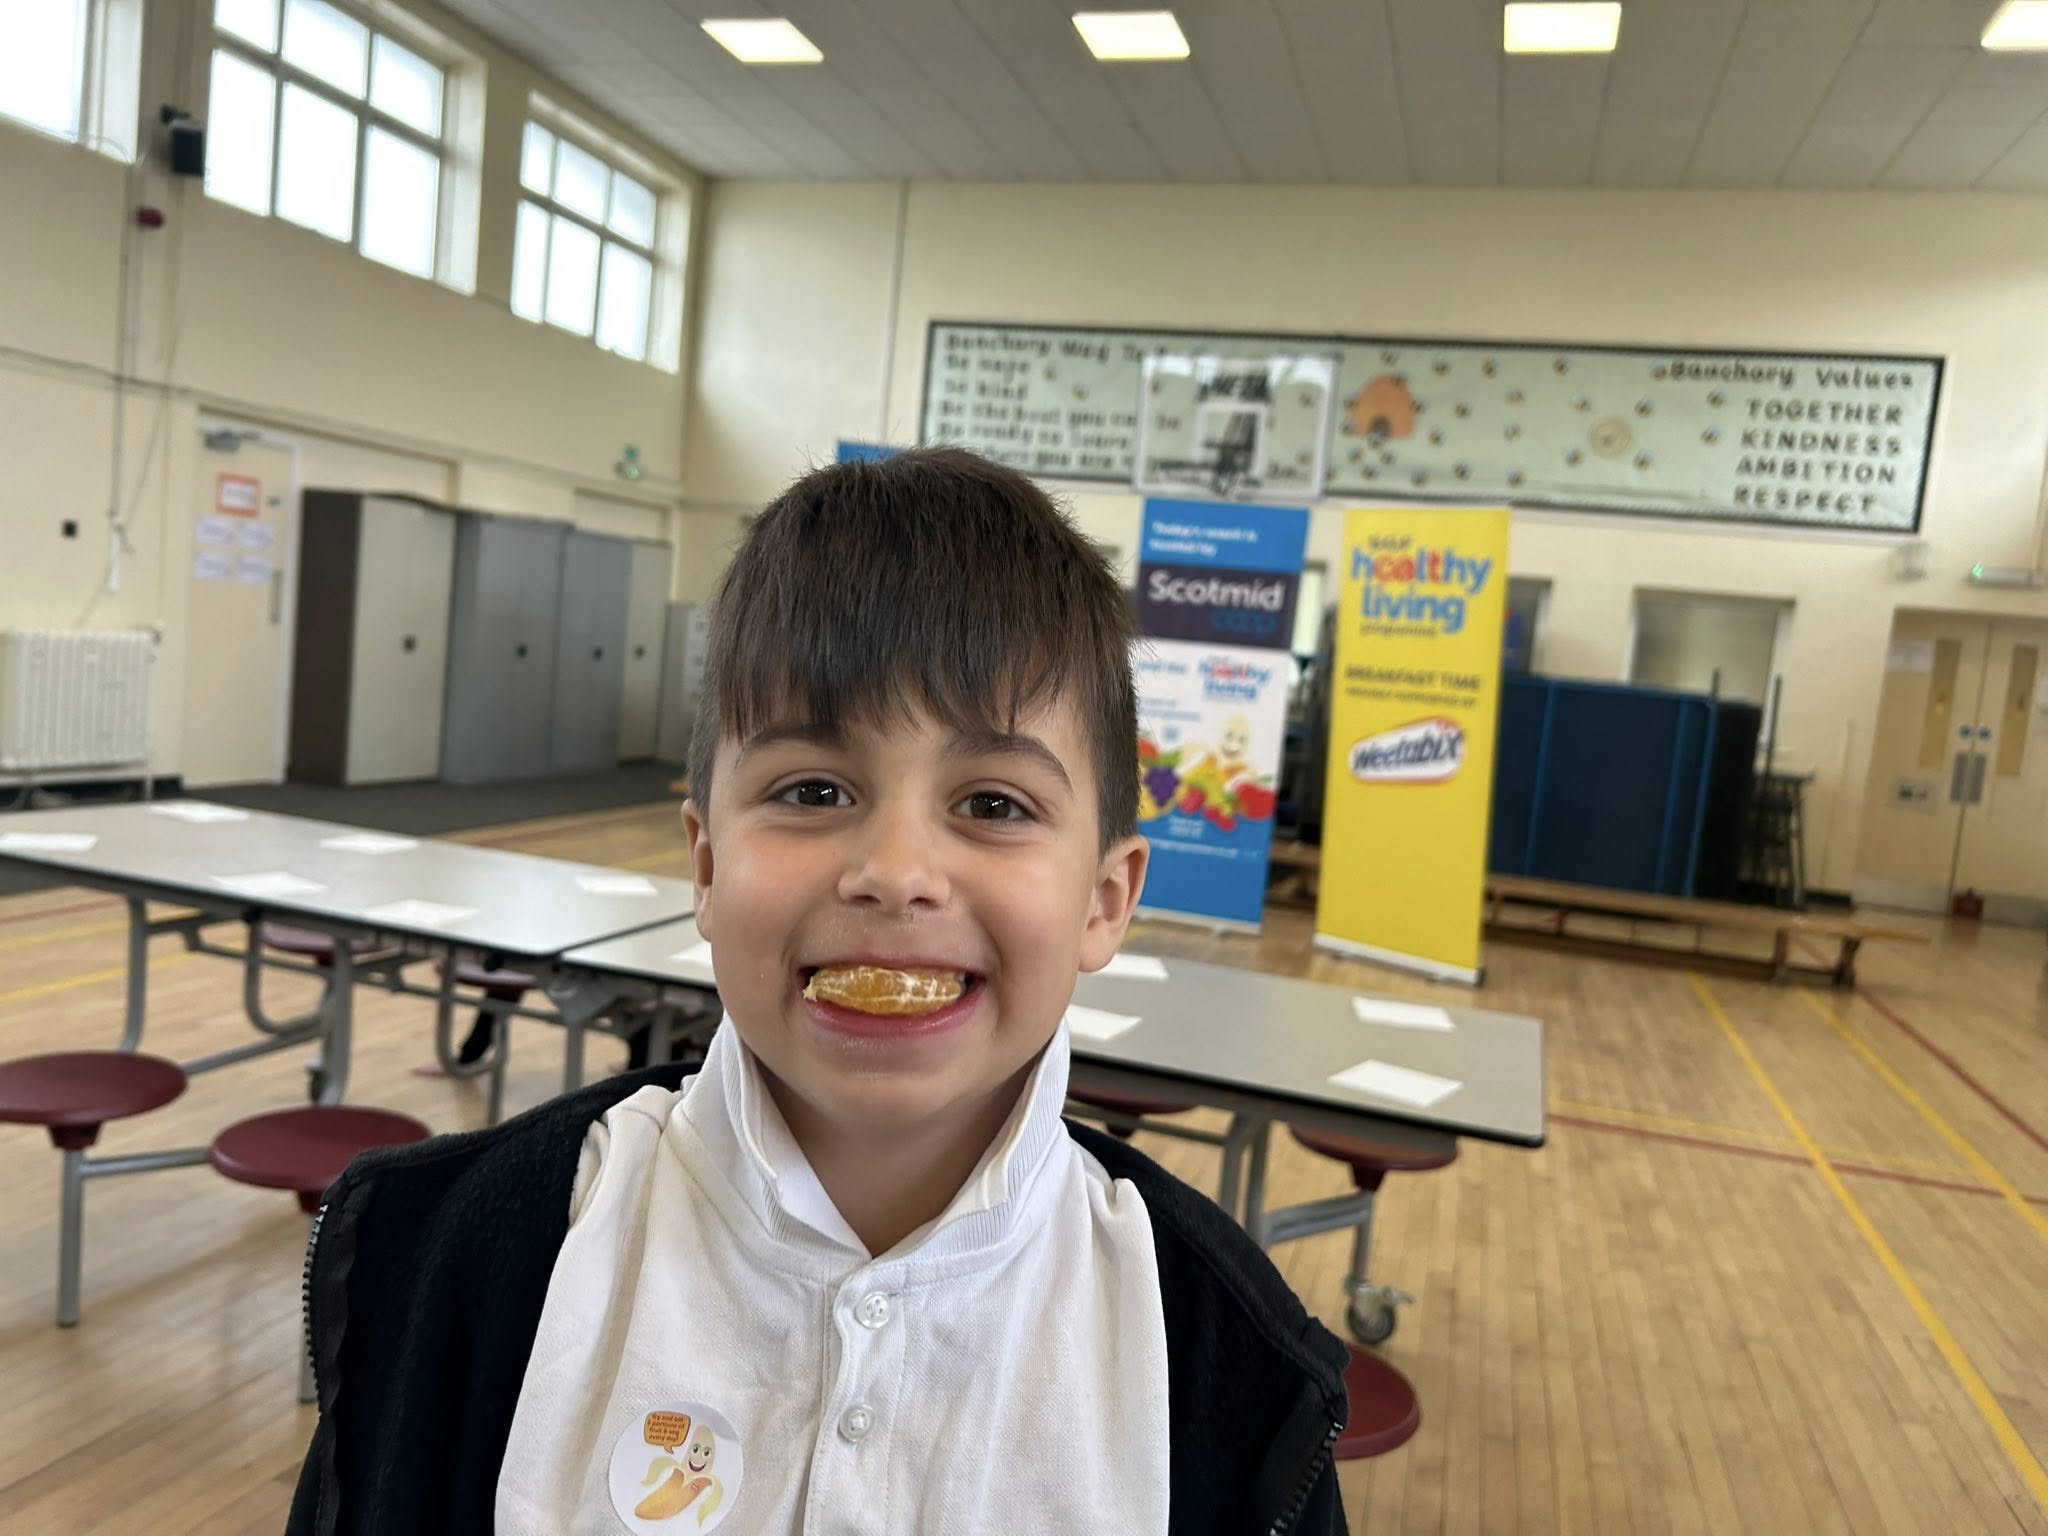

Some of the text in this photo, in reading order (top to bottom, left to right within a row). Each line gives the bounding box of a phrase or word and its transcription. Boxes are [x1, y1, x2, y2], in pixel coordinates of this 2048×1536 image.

[1670, 360, 1914, 391] Banchory Values
[1748, 397, 1903, 427] TOGETHER
[1740, 428, 1902, 458] KINDNESS
[1735, 455, 1896, 484] AMBITION
[1732, 484, 1877, 516] RESPECT
[1350, 546, 1493, 597] healthy
[1148, 569, 1287, 613] Scotmid
[1362, 582, 1466, 635] living
[1345, 665, 1481, 692] BREAKFAST TIME
